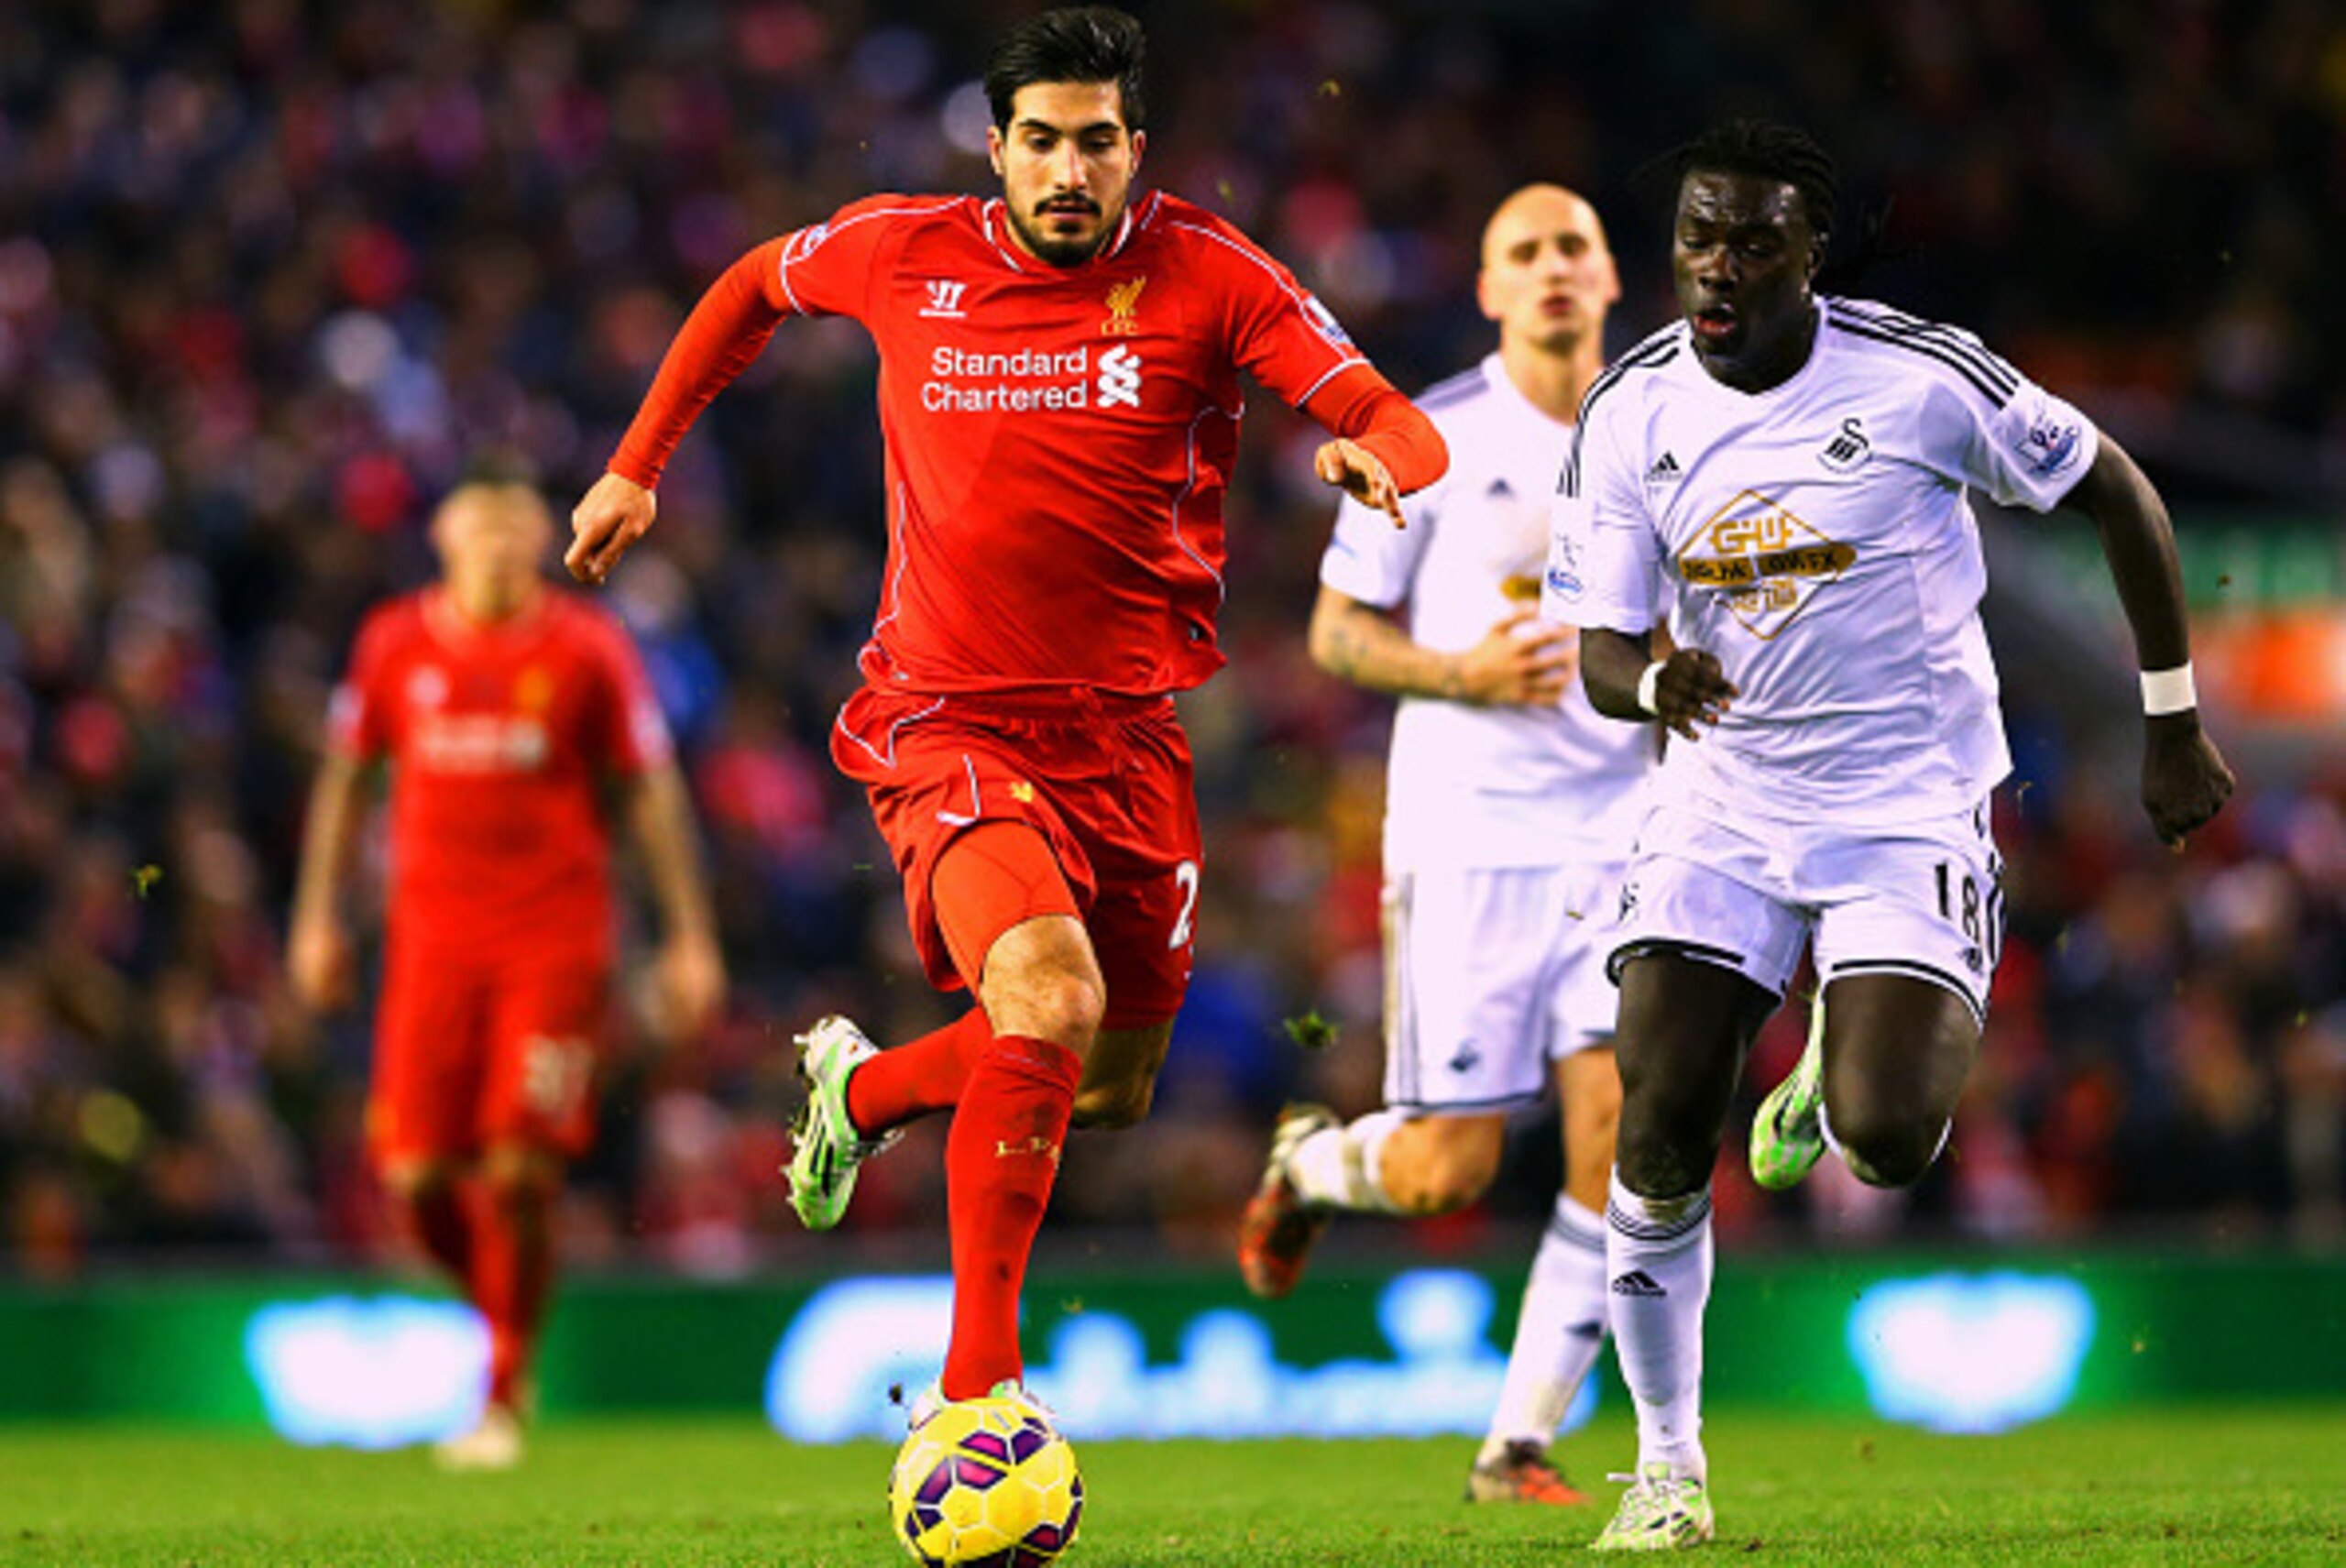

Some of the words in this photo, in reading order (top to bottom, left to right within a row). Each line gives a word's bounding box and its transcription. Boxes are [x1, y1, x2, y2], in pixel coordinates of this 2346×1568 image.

[1101, 321, 1139, 336] LFC
[931, 345, 1088, 377] Standard
[921, 379, 1087, 411] Chartered
[1935, 860, 1980, 944] 18
